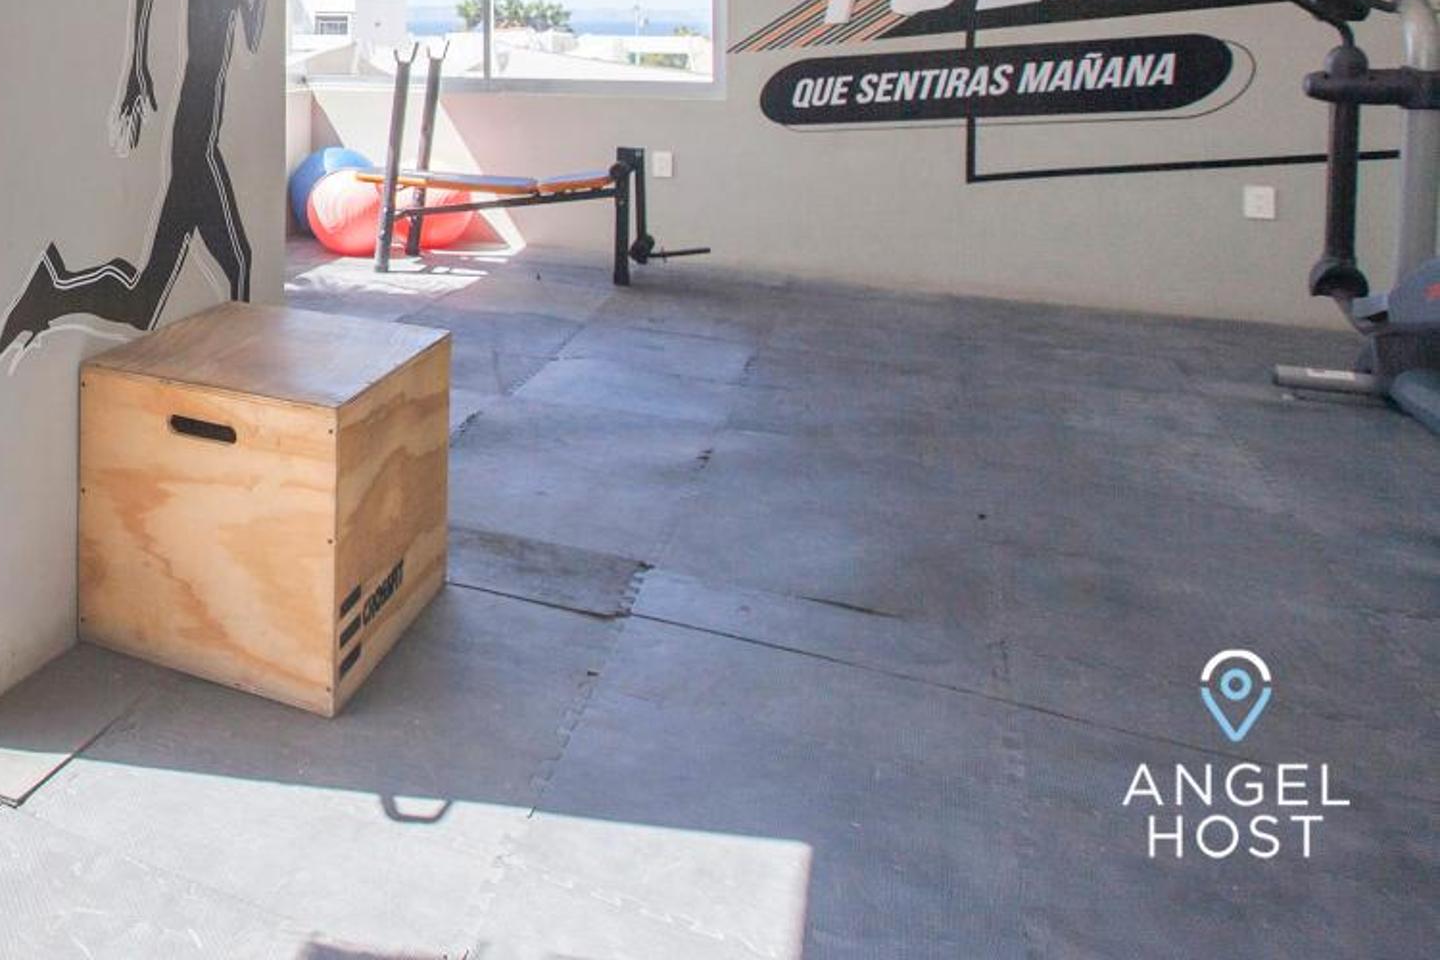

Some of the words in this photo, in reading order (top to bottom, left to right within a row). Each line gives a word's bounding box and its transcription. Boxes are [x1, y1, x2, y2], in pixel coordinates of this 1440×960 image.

[792, 72, 854, 109] QUE
[857, 60, 1010, 104] SENTIRAS
[1016, 52, 1176, 96] MAÑANA
